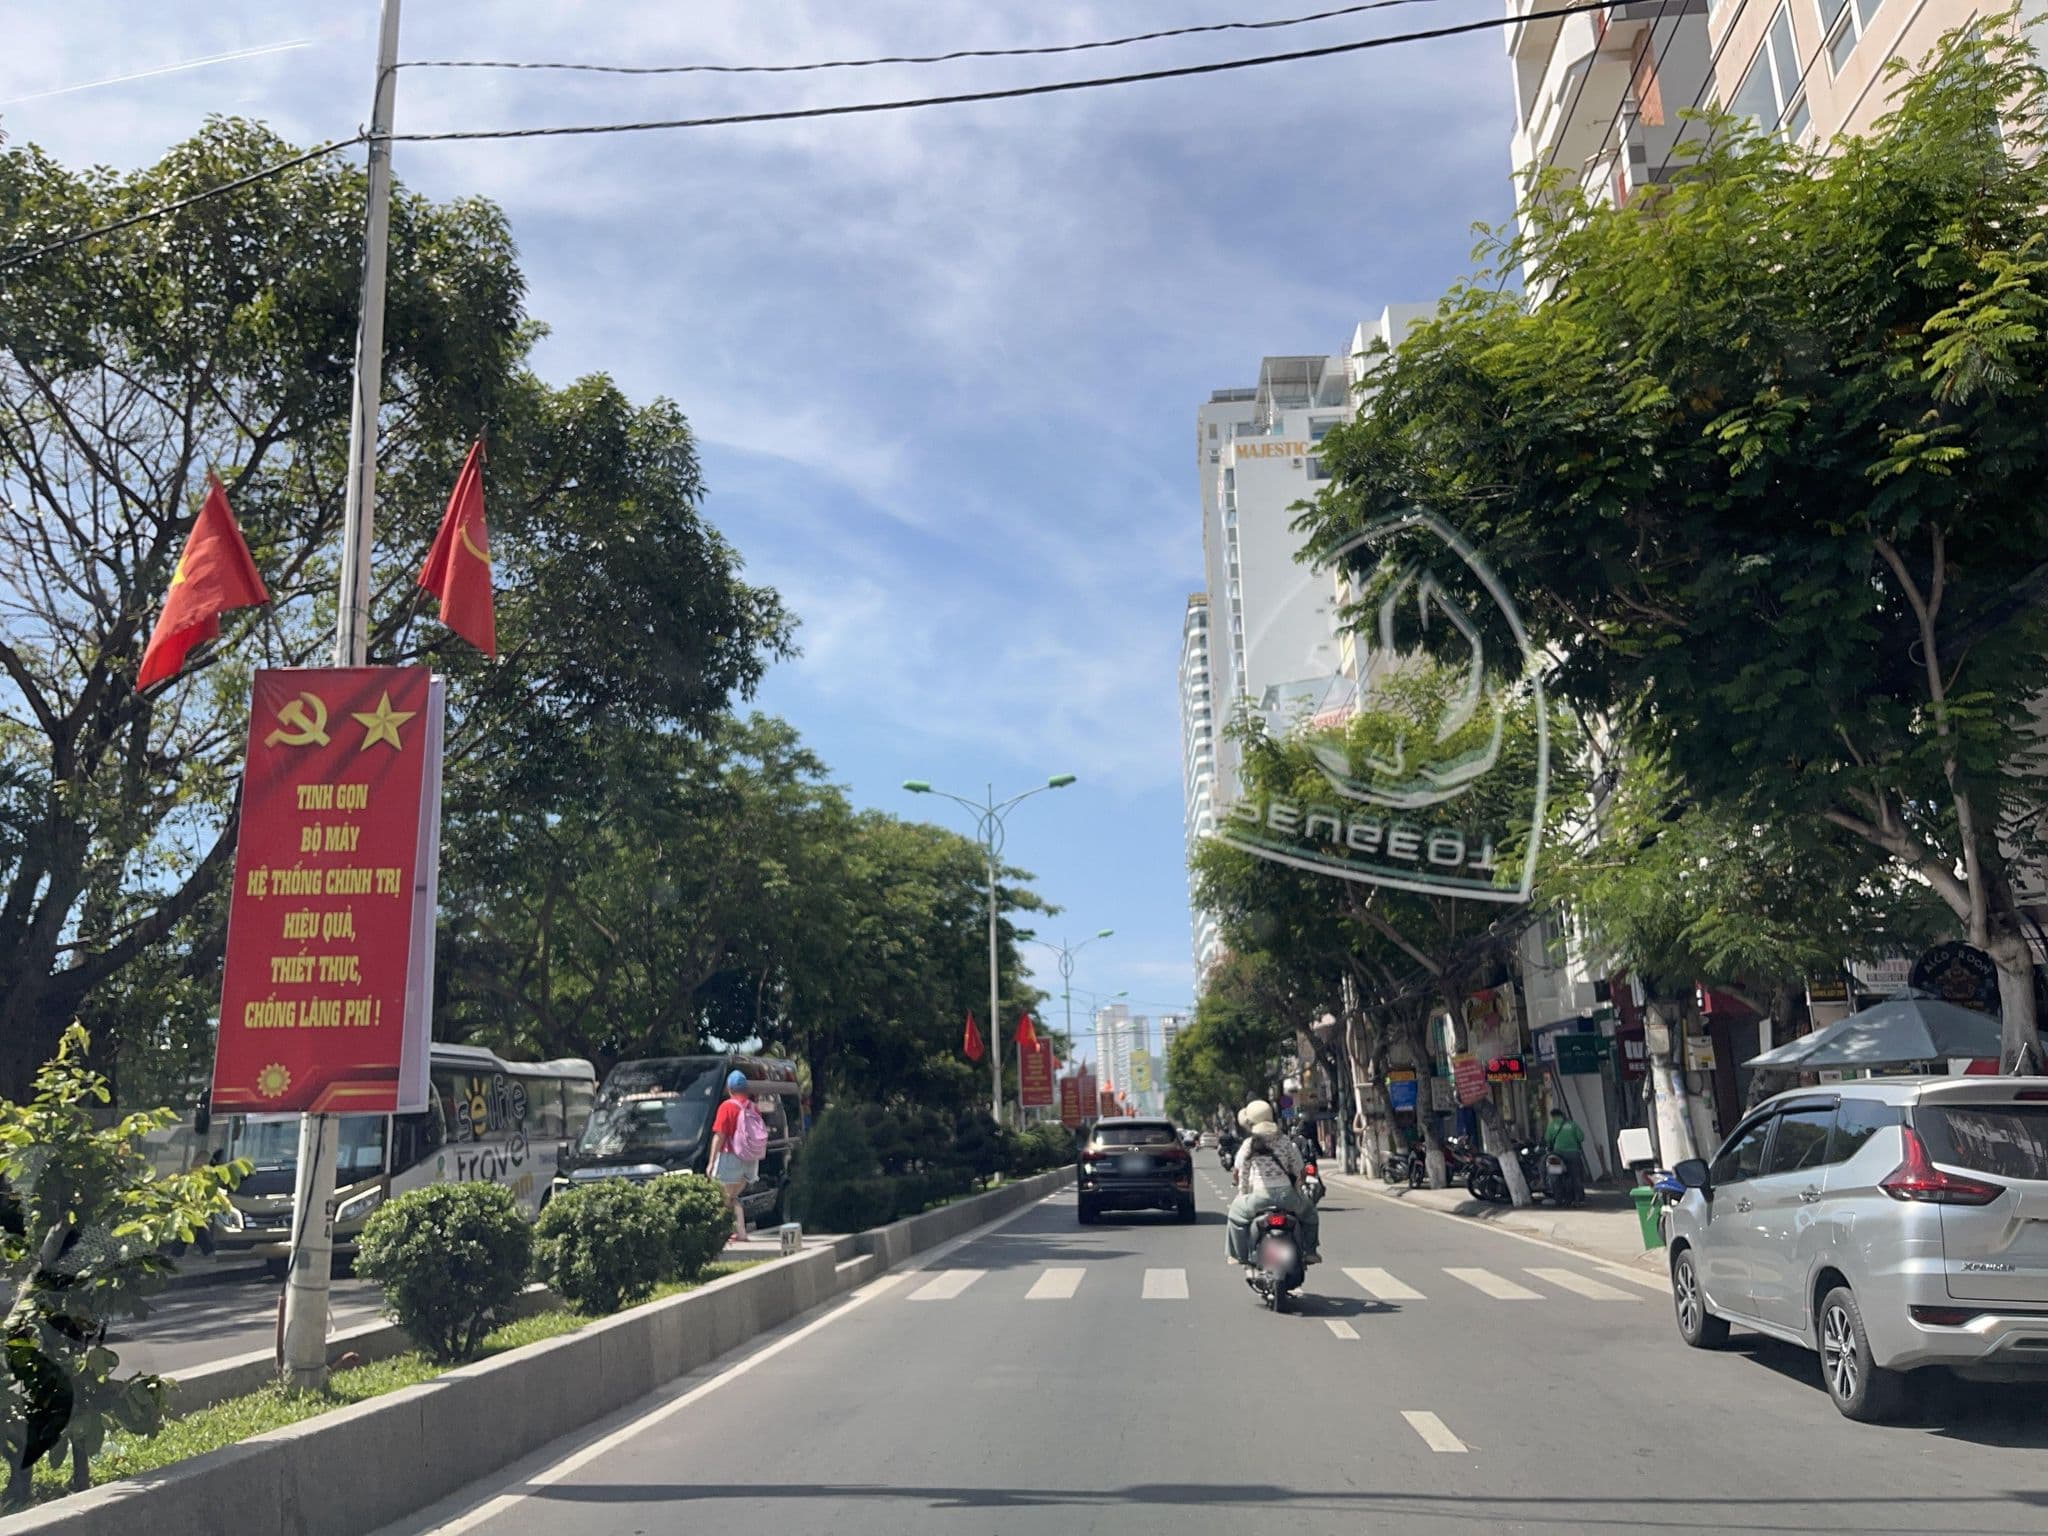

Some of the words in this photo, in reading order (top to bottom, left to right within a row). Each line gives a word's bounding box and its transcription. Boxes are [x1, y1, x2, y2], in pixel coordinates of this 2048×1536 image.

[1235, 441, 1309, 458] MAJESTIC
[296, 784, 334, 810] TINH
[336, 784, 369, 814] GỌN
[300, 821, 323, 857] BỘ
[246, 864, 268, 901] HỆ
[271, 860, 323, 896] THỐNG
[325, 864, 373, 895] CHÍNH
[375, 868, 402, 899] TRỊ
[283, 907, 321, 944] HIỆU
[322, 904, 356, 943] QUẢ,
[271, 947, 317, 984] THIẾT
[319, 955, 363, 987] THỰC,
[244, 991, 297, 1029] CHỐNG
[343, 994, 373, 1027] PHÍ
[374, 999, 382, 1027] !
